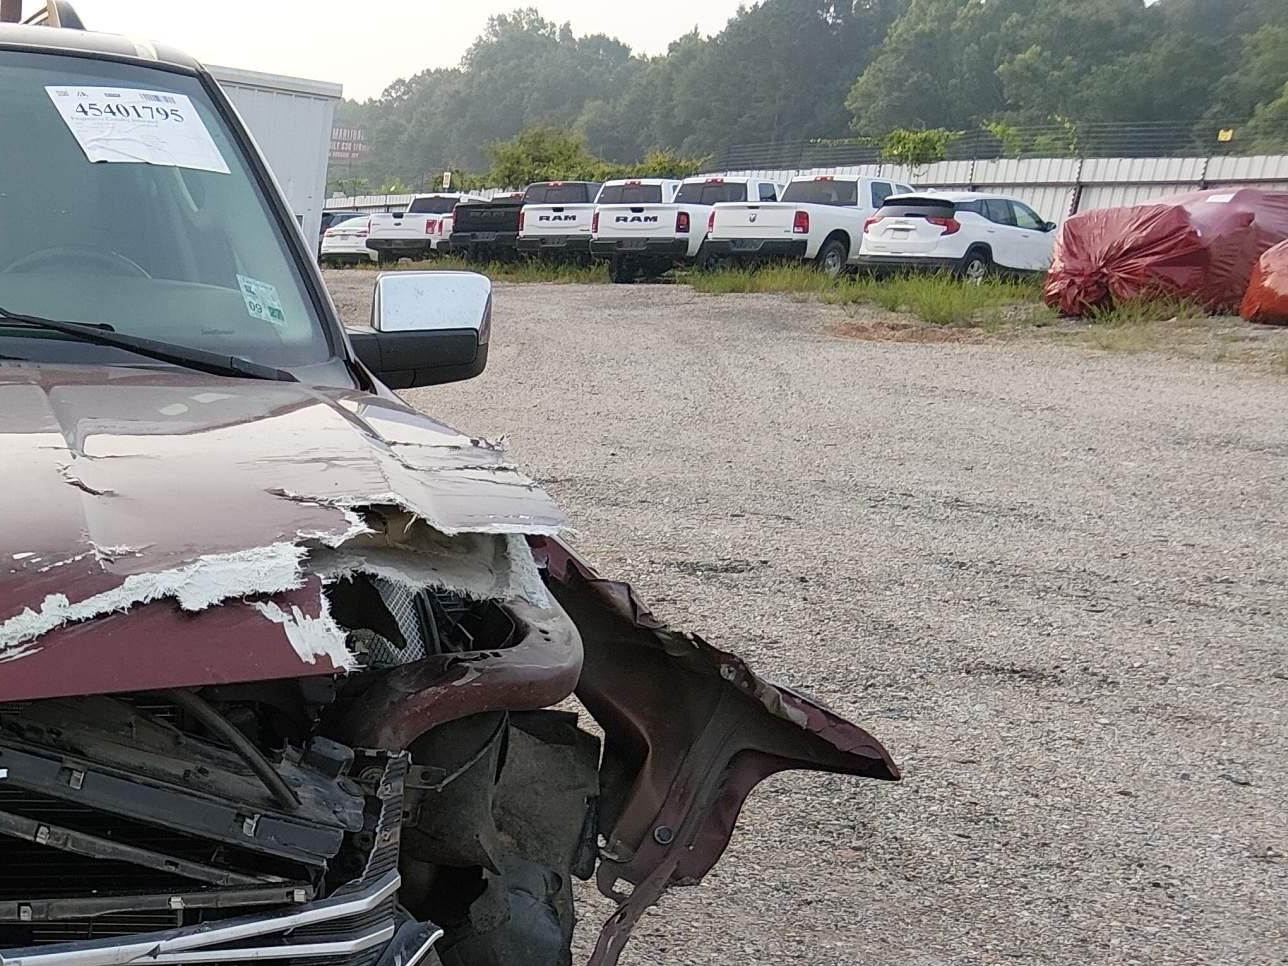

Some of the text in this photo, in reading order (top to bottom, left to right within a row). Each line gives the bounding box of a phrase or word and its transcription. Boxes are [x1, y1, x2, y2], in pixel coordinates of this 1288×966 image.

[74, 102, 185, 123] 45401795
[538, 214, 577, 222] RAM
[615, 215, 658, 223] RAM
